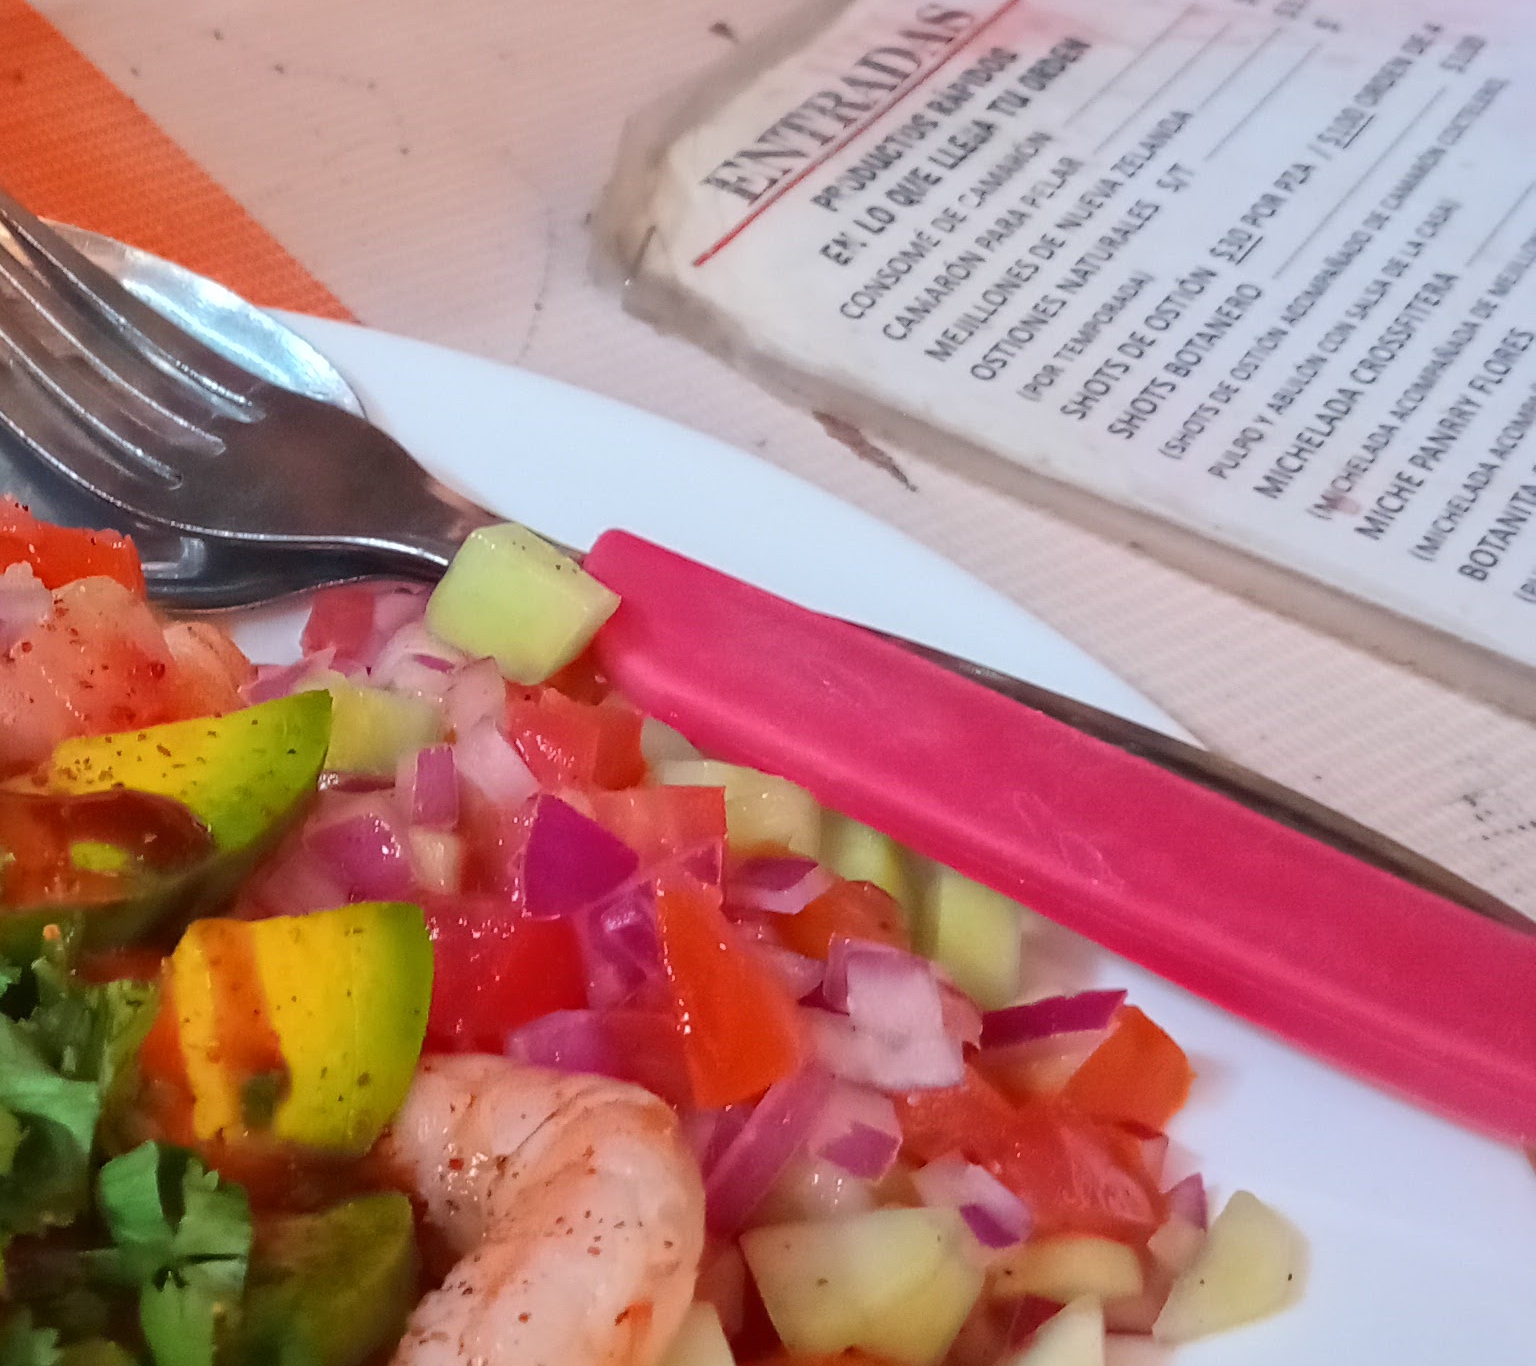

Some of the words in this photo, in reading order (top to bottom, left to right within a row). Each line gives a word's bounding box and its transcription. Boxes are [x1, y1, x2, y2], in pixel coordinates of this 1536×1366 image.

[699, 1, 976, 206] ENTRADAS
[853, 205, 897, 234] LO
[885, 168, 940, 207] QUE
[986, 90, 1030, 120] TU
[1017, 37, 1088, 91] ORDEN
[839, 230, 938, 319] CONSOMÉ
[930, 207, 966, 232] DE
[882, 251, 984, 340] CAMARÓN
[975, 208, 1028, 249] PARA
[1020, 157, 1080, 208] PELAR
[926, 260, 1037, 361] MEJILLONES
[1028, 233, 1064, 259] DE
[1056, 178, 1119, 232] NUEVA
[1112, 109, 1190, 177] ZELANDA
[969, 295, 1064, 381] OSTIONES
[1058, 200, 1158, 293] NATURALES
[1018, 365, 1062, 401] (POR
[1055, 271, 1154, 362] TEMPORADA)
[1061, 359, 1129, 418] SHOTS
[1118, 331, 1155, 358] DE
[1144, 266, 1215, 330] OSTIÓN
[1210, 227, 1252, 261] $30
[1242, 192, 1284, 227] POR
[1274, 161, 1313, 192] PZA
[1160, 404, 1218, 458] (SHOTS
[1209, 381, 1238, 403] DE
[1230, 326, 1286, 380] OSTIÓN
[1280, 231, 1371, 324] ACOMPAÑADO
[1363, 211, 1389, 230] DE
[1108, 377, 1175, 438] SHOTS
[1165, 283, 1261, 376] BOTANERO
[1208, 427, 1263, 478] PULPO
[1253, 414, 1274, 428] Y
[1266, 354, 1325, 413] ABULÓN
[1318, 320, 1355, 352] CON
[1345, 278, 1390, 320] SALSA
[1381, 257, 1408, 277] DE
[1401, 239, 1424, 255] LA
[1255, 386, 1361, 497] MICHELADA
[1350, 270, 1456, 384] CROSSFITERA
[1307, 422, 1398, 519] (MICHELADA
[1389, 319, 1479, 419] ACOMPAÑADA
[1469, 298, 1497, 319] DE
[1355, 472, 1422, 538] MICHE
[1409, 396, 1481, 470] PANRRY
[1470, 327, 1534, 393] FLORES
[1412, 461, 1498, 561] (MICHELADA
